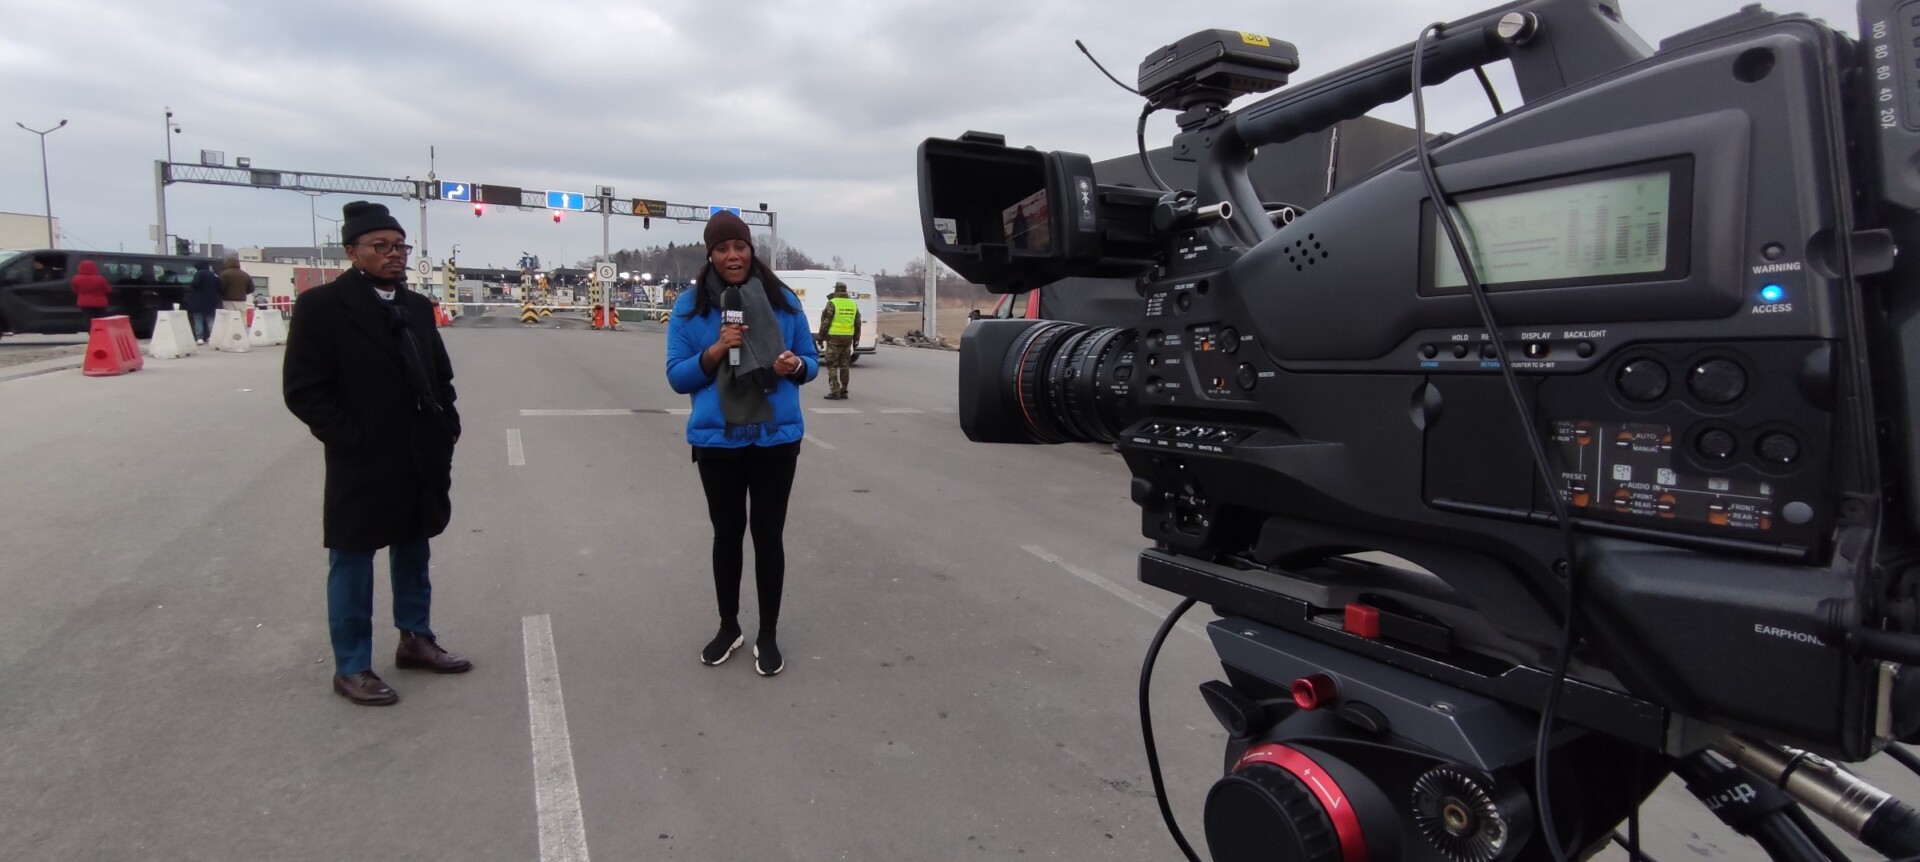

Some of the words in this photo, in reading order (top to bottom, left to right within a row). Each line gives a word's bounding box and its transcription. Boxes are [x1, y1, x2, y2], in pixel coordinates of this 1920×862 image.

[1872, 20, 1886, 39] 100
[1874, 44, 1888, 59] 80
[1876, 65, 1890, 80] 60
[1879, 87, 1893, 102] 40
[1752, 261, 1801, 274] WARNING
[1751, 303, 1792, 314] ACCESS
[1521, 332, 1551, 340] DISPLAY
[1564, 330, 1607, 339] BACKLIGHT
[1635, 432, 1657, 440] AUTO
[1632, 445, 1659, 453] MANUAL
[1615, 465, 1629, 473] CH
[1561, 472, 1587, 481] PRESET
[1620, 471, 1625, 479] 1
[1627, 482, 1650, 490] AUDIO
[1632, 492, 1654, 500] FRONT
[1731, 503, 1755, 512] FRONT
[1732, 513, 1752, 521] REAR
